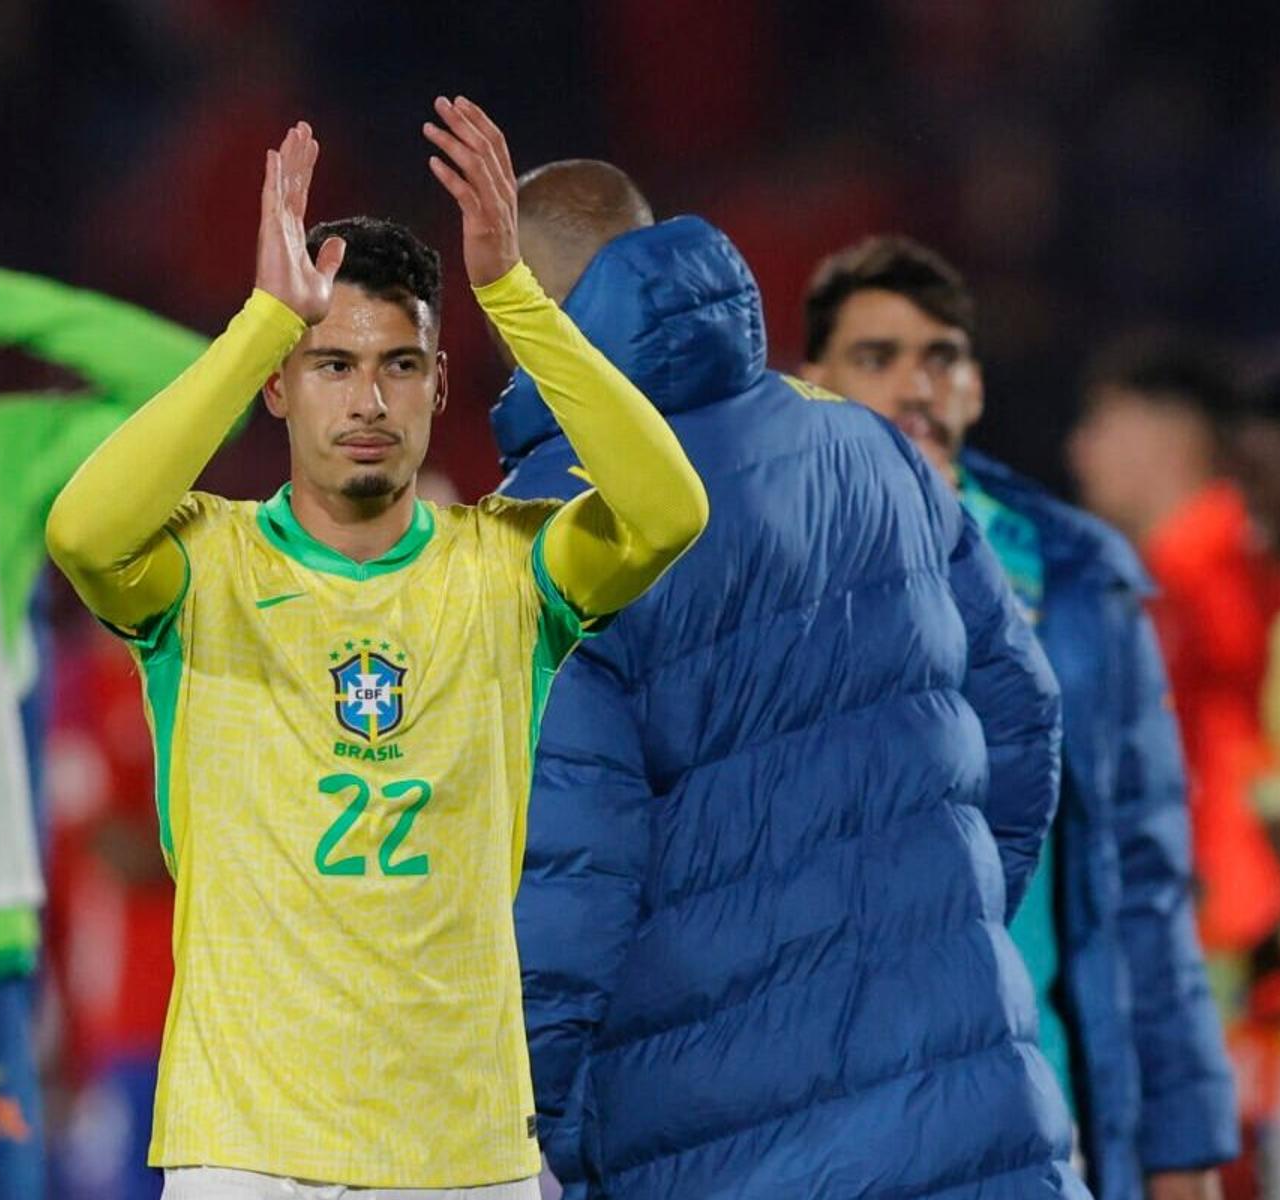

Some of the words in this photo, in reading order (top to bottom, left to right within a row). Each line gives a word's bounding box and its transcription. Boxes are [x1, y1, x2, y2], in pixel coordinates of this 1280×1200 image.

[354, 688, 382, 700] CBF
[333, 742, 404, 762] BRASIL
[314, 772, 432, 876] 22
